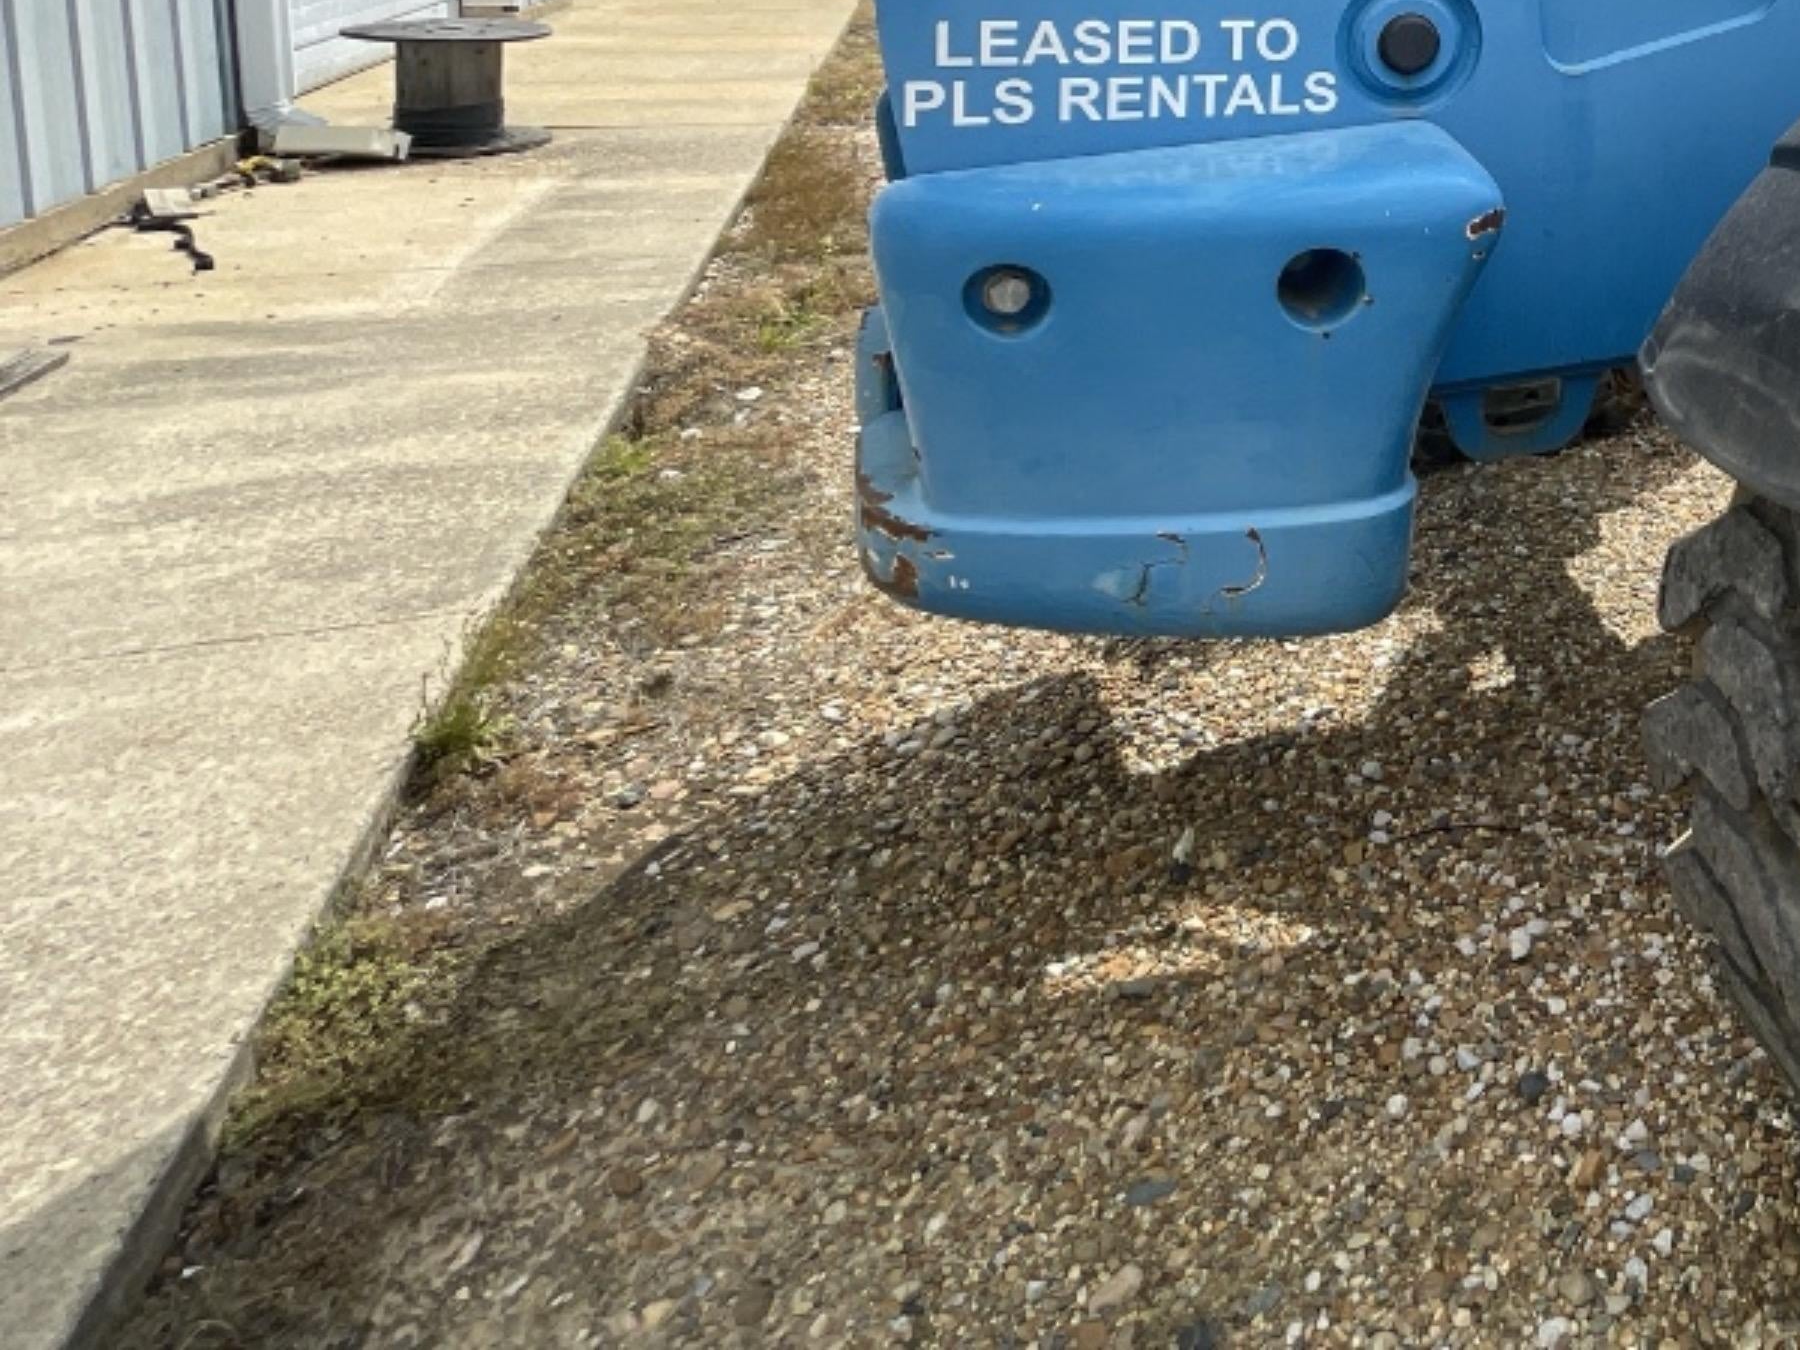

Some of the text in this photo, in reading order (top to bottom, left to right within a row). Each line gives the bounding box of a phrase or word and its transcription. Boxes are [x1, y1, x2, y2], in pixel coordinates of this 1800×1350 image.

[936, 18, 1298, 67] LEASED TO
[904, 71, 1338, 127] PLS RENTALS
